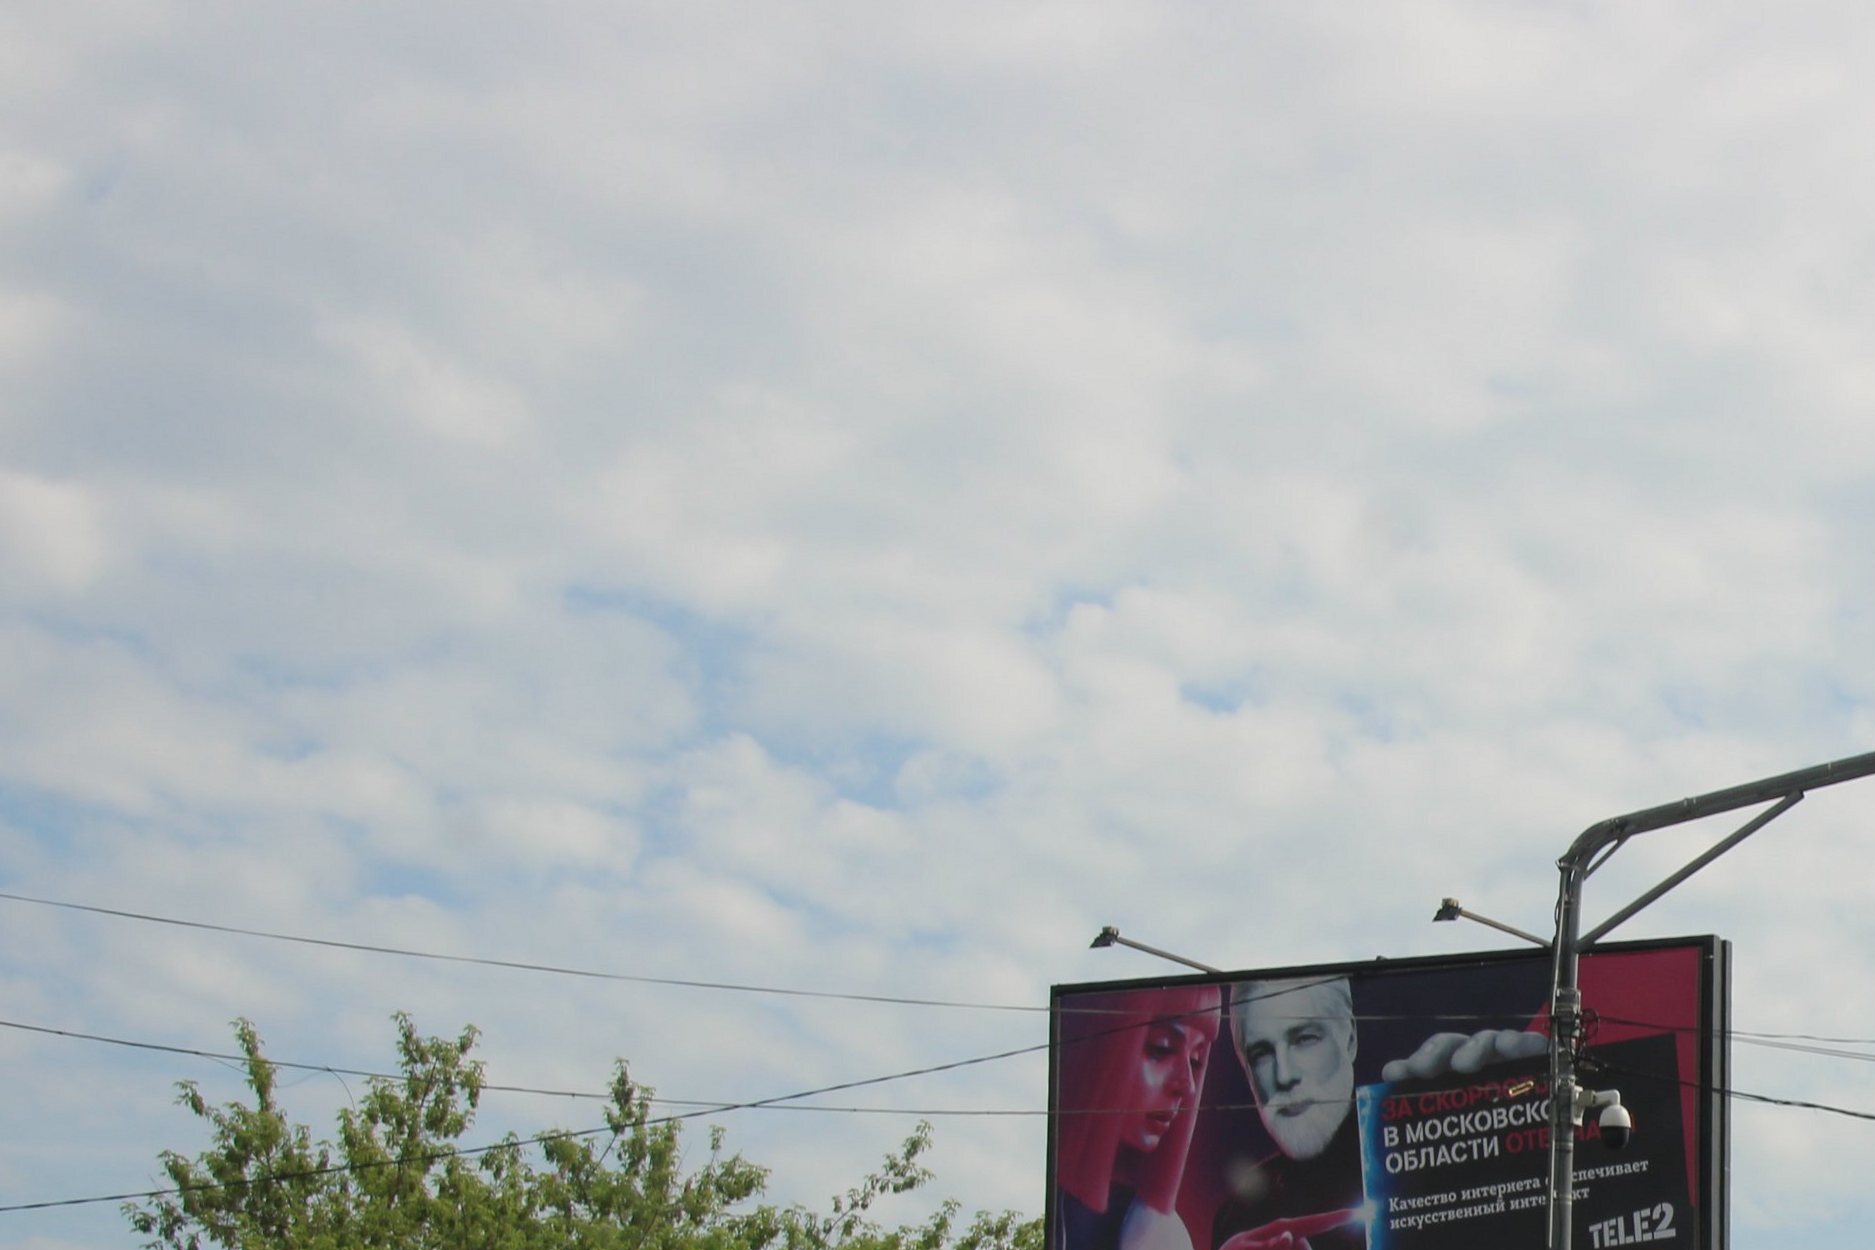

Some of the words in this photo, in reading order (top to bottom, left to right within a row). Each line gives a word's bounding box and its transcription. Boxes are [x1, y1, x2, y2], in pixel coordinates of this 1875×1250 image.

[1382, 1096, 1413, 1121] ЗА
[1384, 1126, 1400, 1148] В
[1405, 1099, 1550, 1144] МОСКОВСКО
[1385, 1135, 1500, 1174] ОБЛАСТИ
[1388, 1189, 1457, 1213] Качество
[1460, 1177, 1541, 1200] интернета
[1389, 1198, 1506, 1230] искусственный
[1589, 1202, 1677, 1250] TELE2
